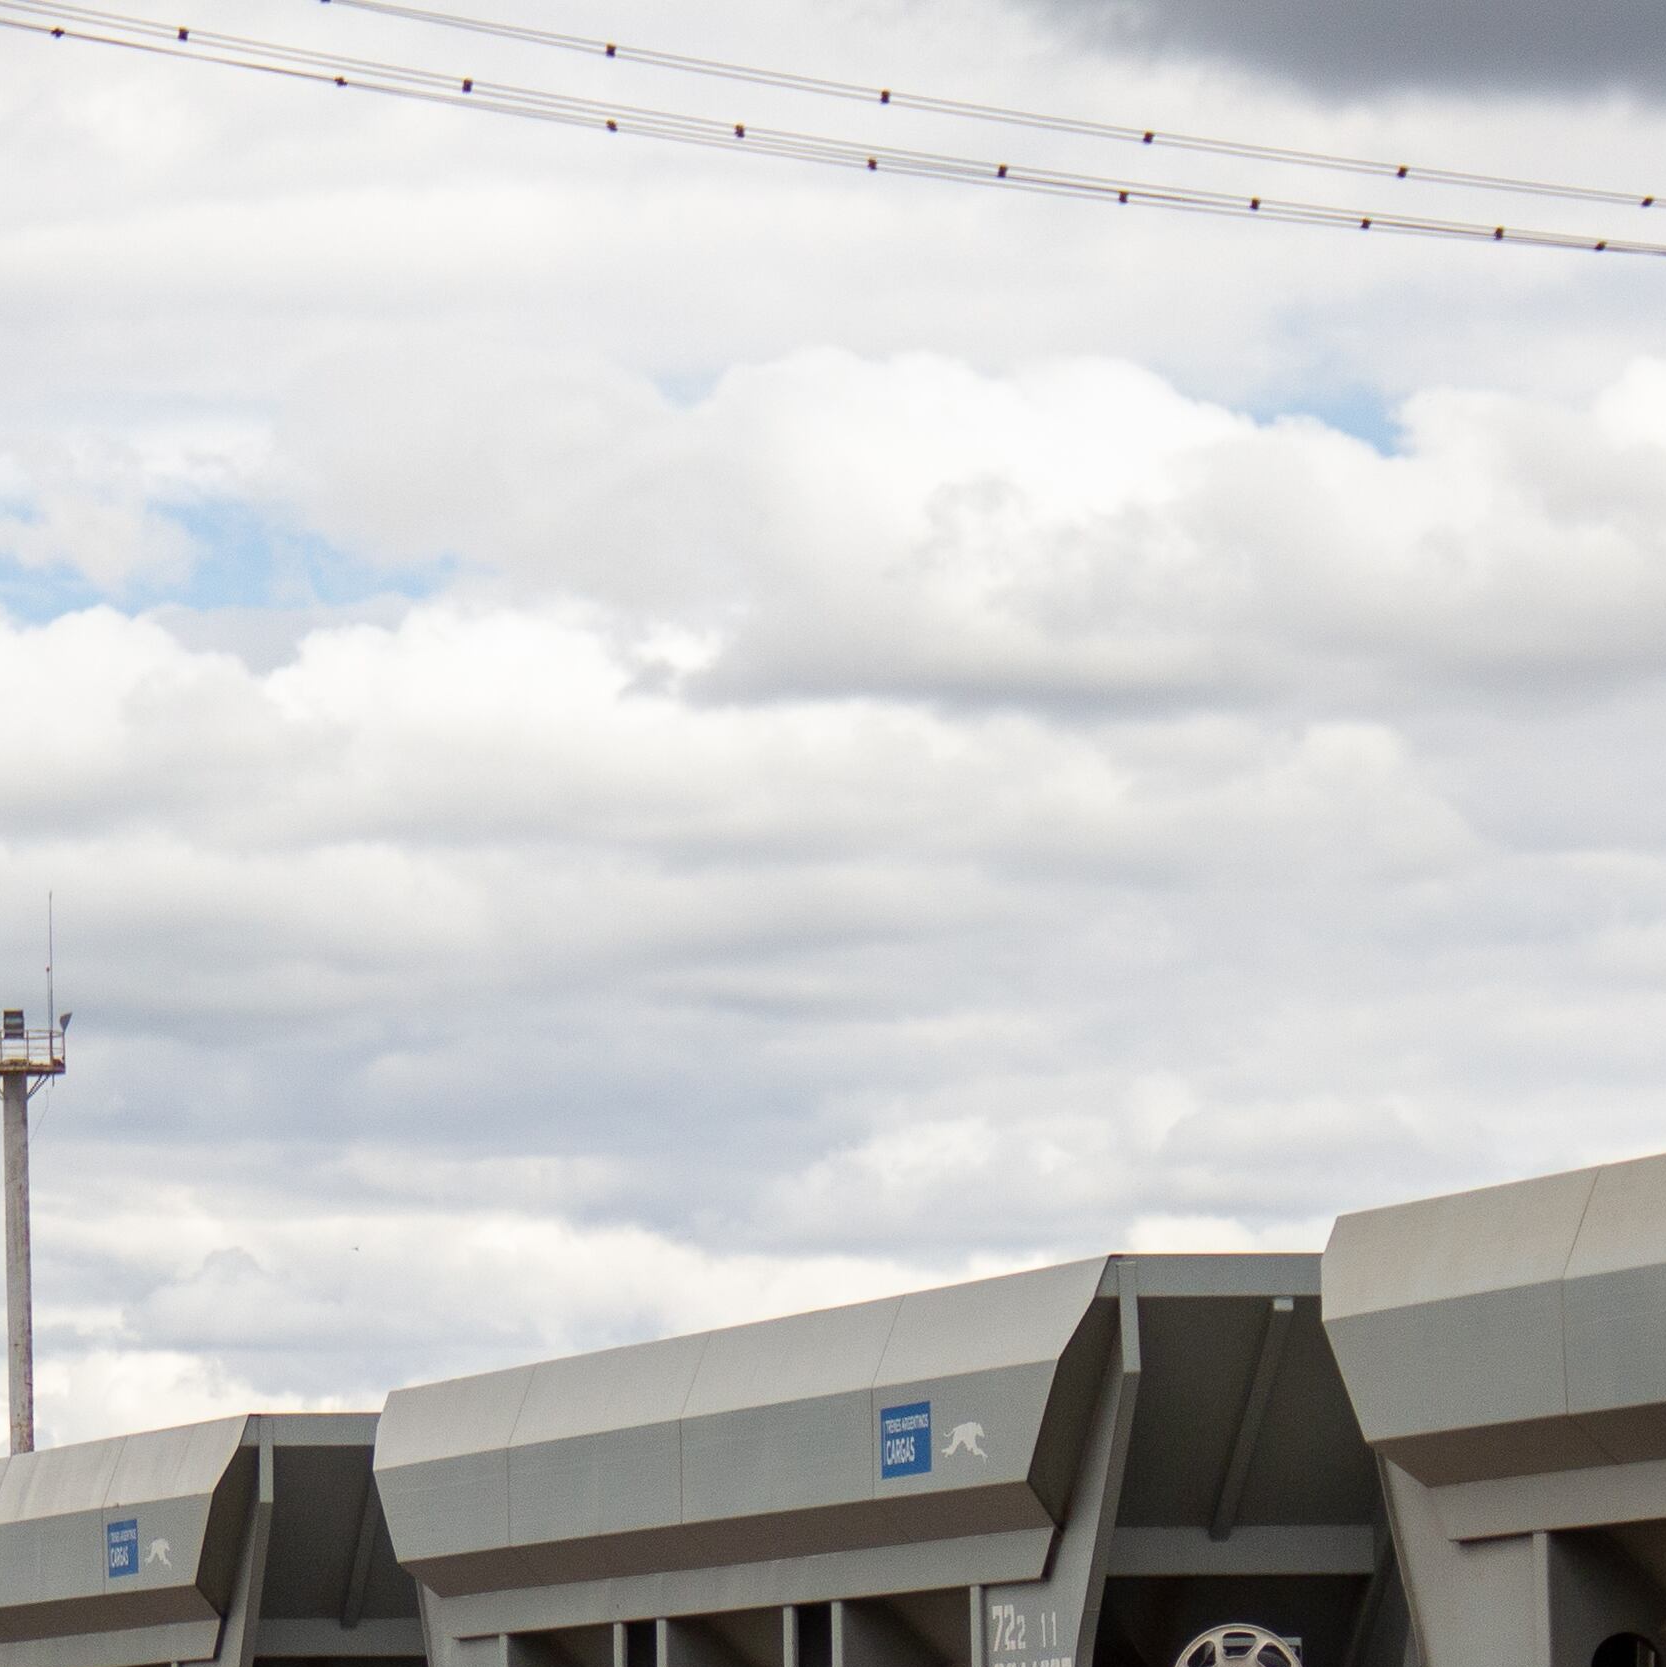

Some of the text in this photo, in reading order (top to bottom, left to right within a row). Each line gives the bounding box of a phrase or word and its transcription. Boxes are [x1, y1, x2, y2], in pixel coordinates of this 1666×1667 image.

[886, 1436, 916, 1466] CARGAS
[992, 1604, 1058, 1652] 722 11
